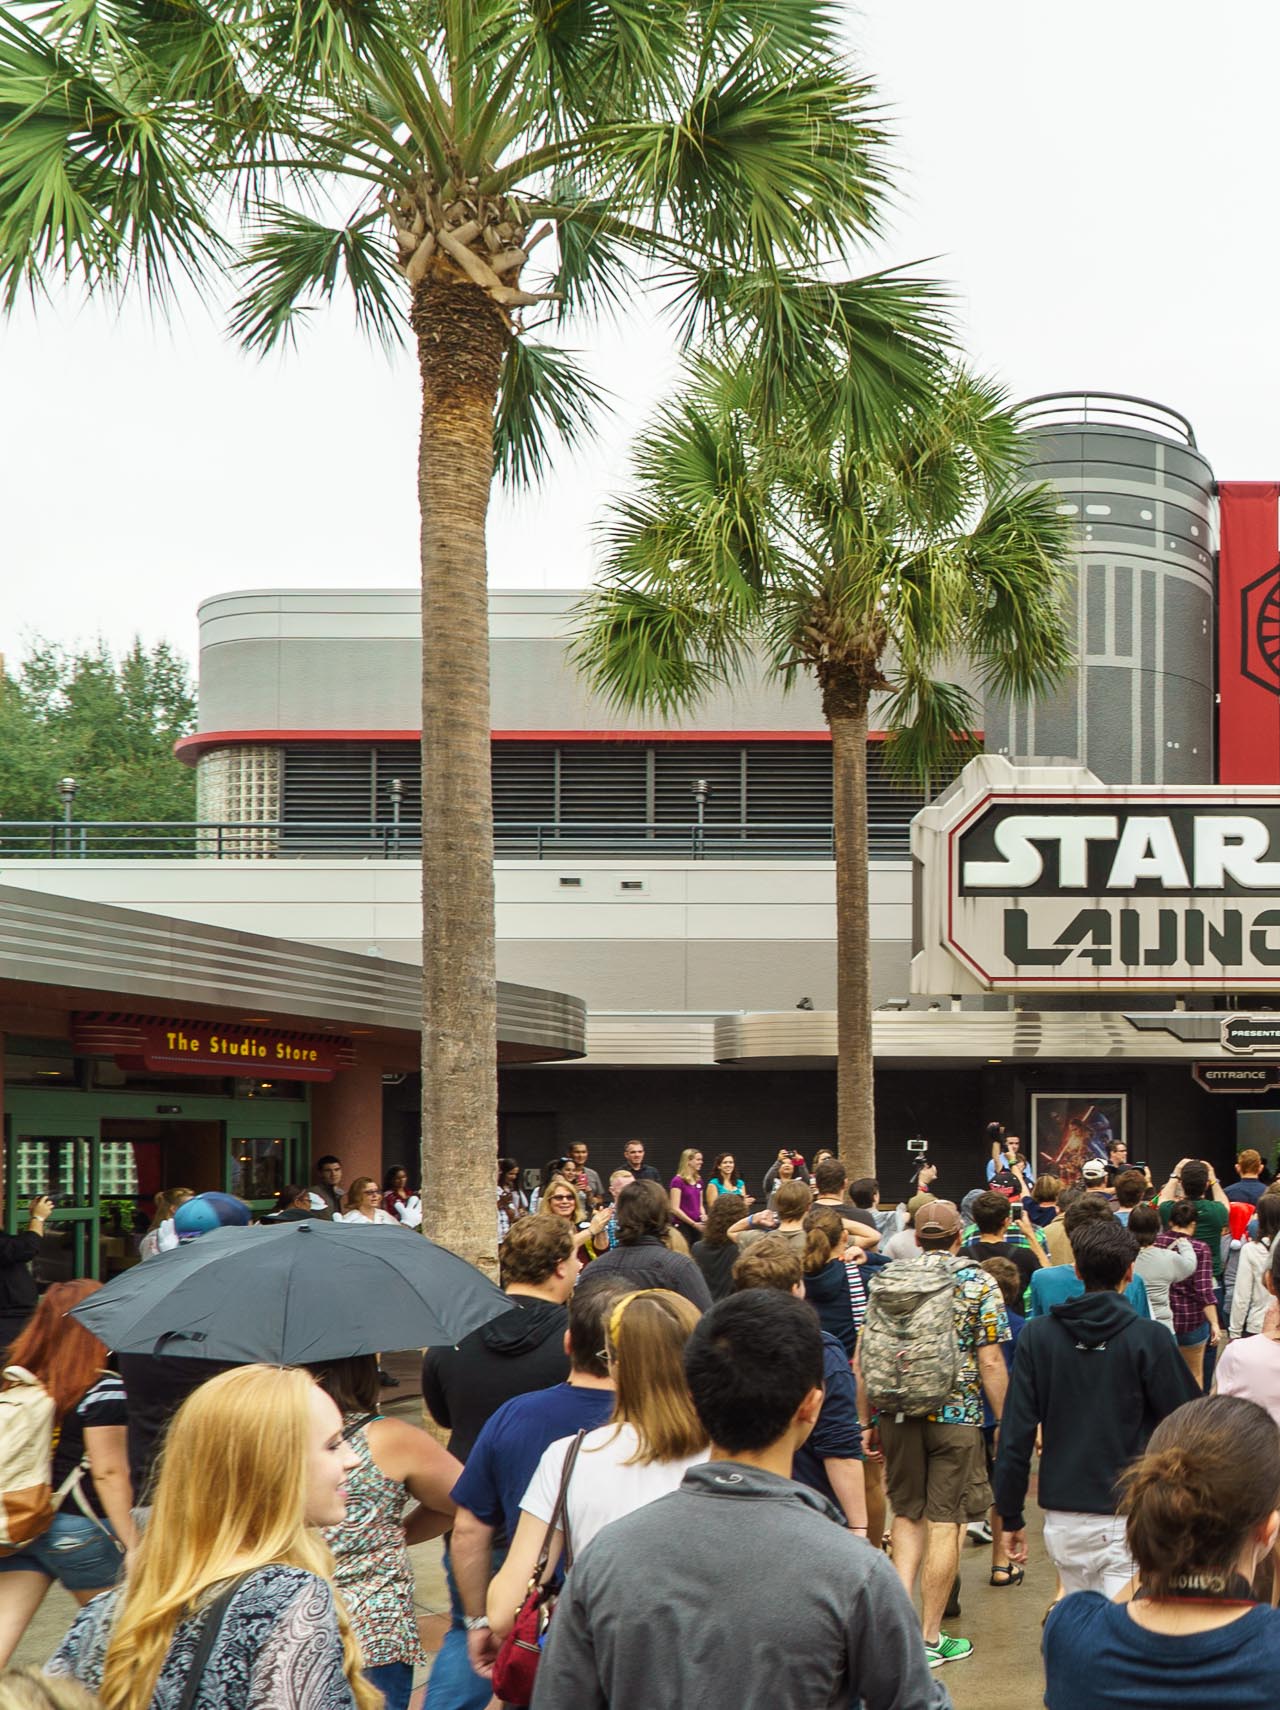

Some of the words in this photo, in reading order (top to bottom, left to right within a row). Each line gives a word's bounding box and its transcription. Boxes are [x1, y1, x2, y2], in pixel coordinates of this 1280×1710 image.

[166, 1032, 200, 1052] The
[209, 1036, 268, 1058] Studio
[276, 1042, 318, 1062] Store
